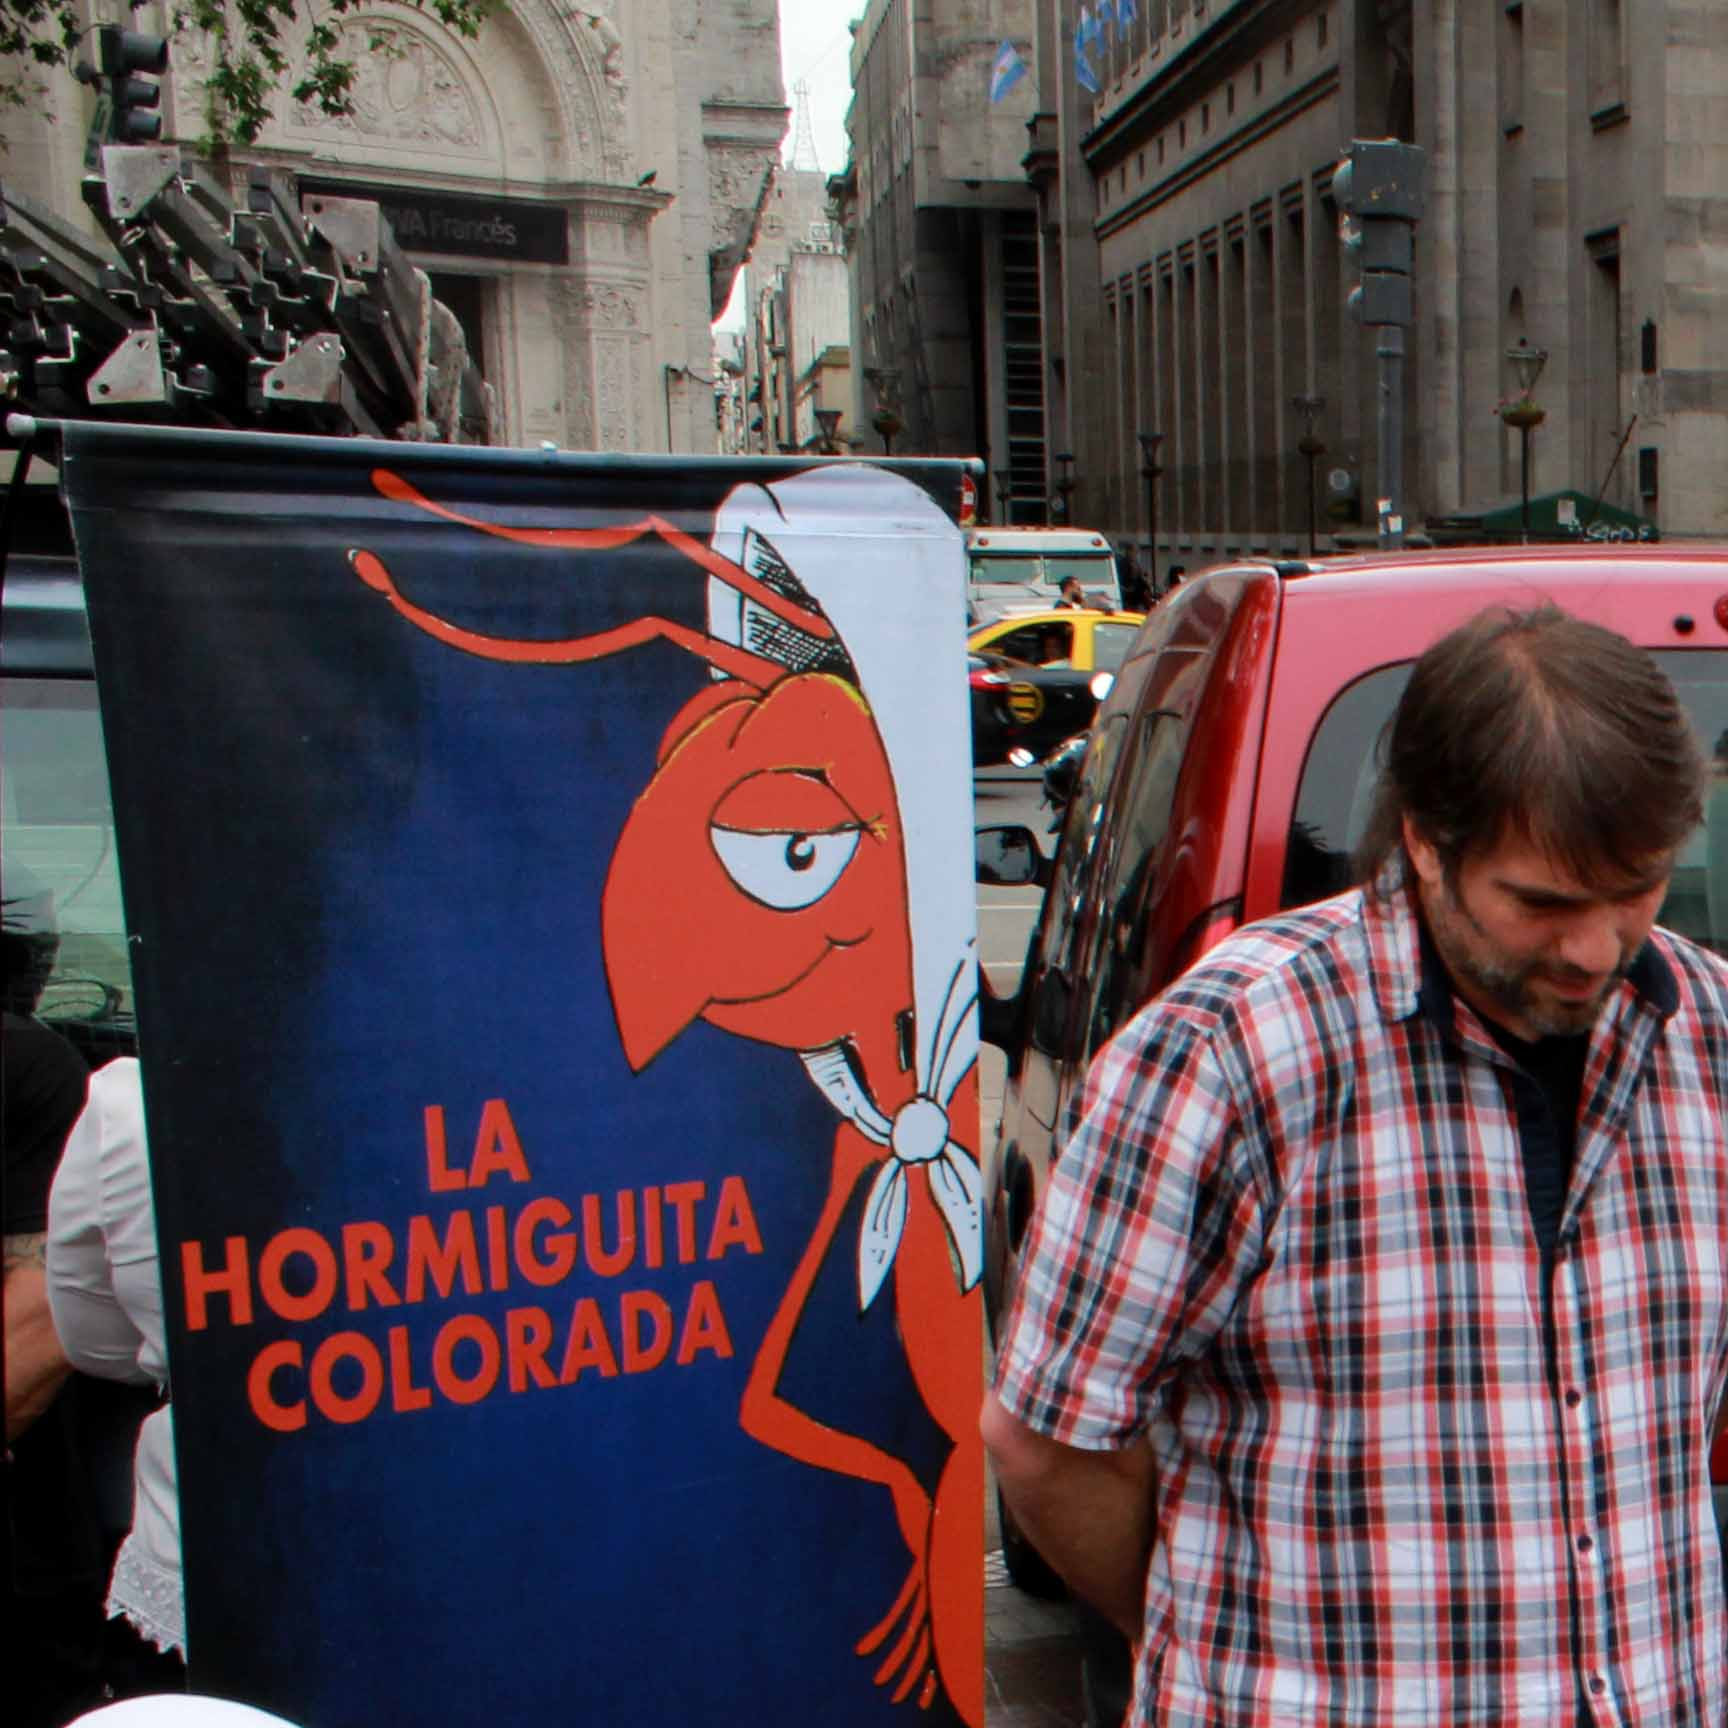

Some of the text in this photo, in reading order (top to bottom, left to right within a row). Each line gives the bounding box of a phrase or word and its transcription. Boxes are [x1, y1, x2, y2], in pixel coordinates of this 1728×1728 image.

[423, 1098, 530, 1193] LA
[181, 1175, 764, 1332] HORMIGUITA
[246, 1280, 735, 1433] COLORADA
